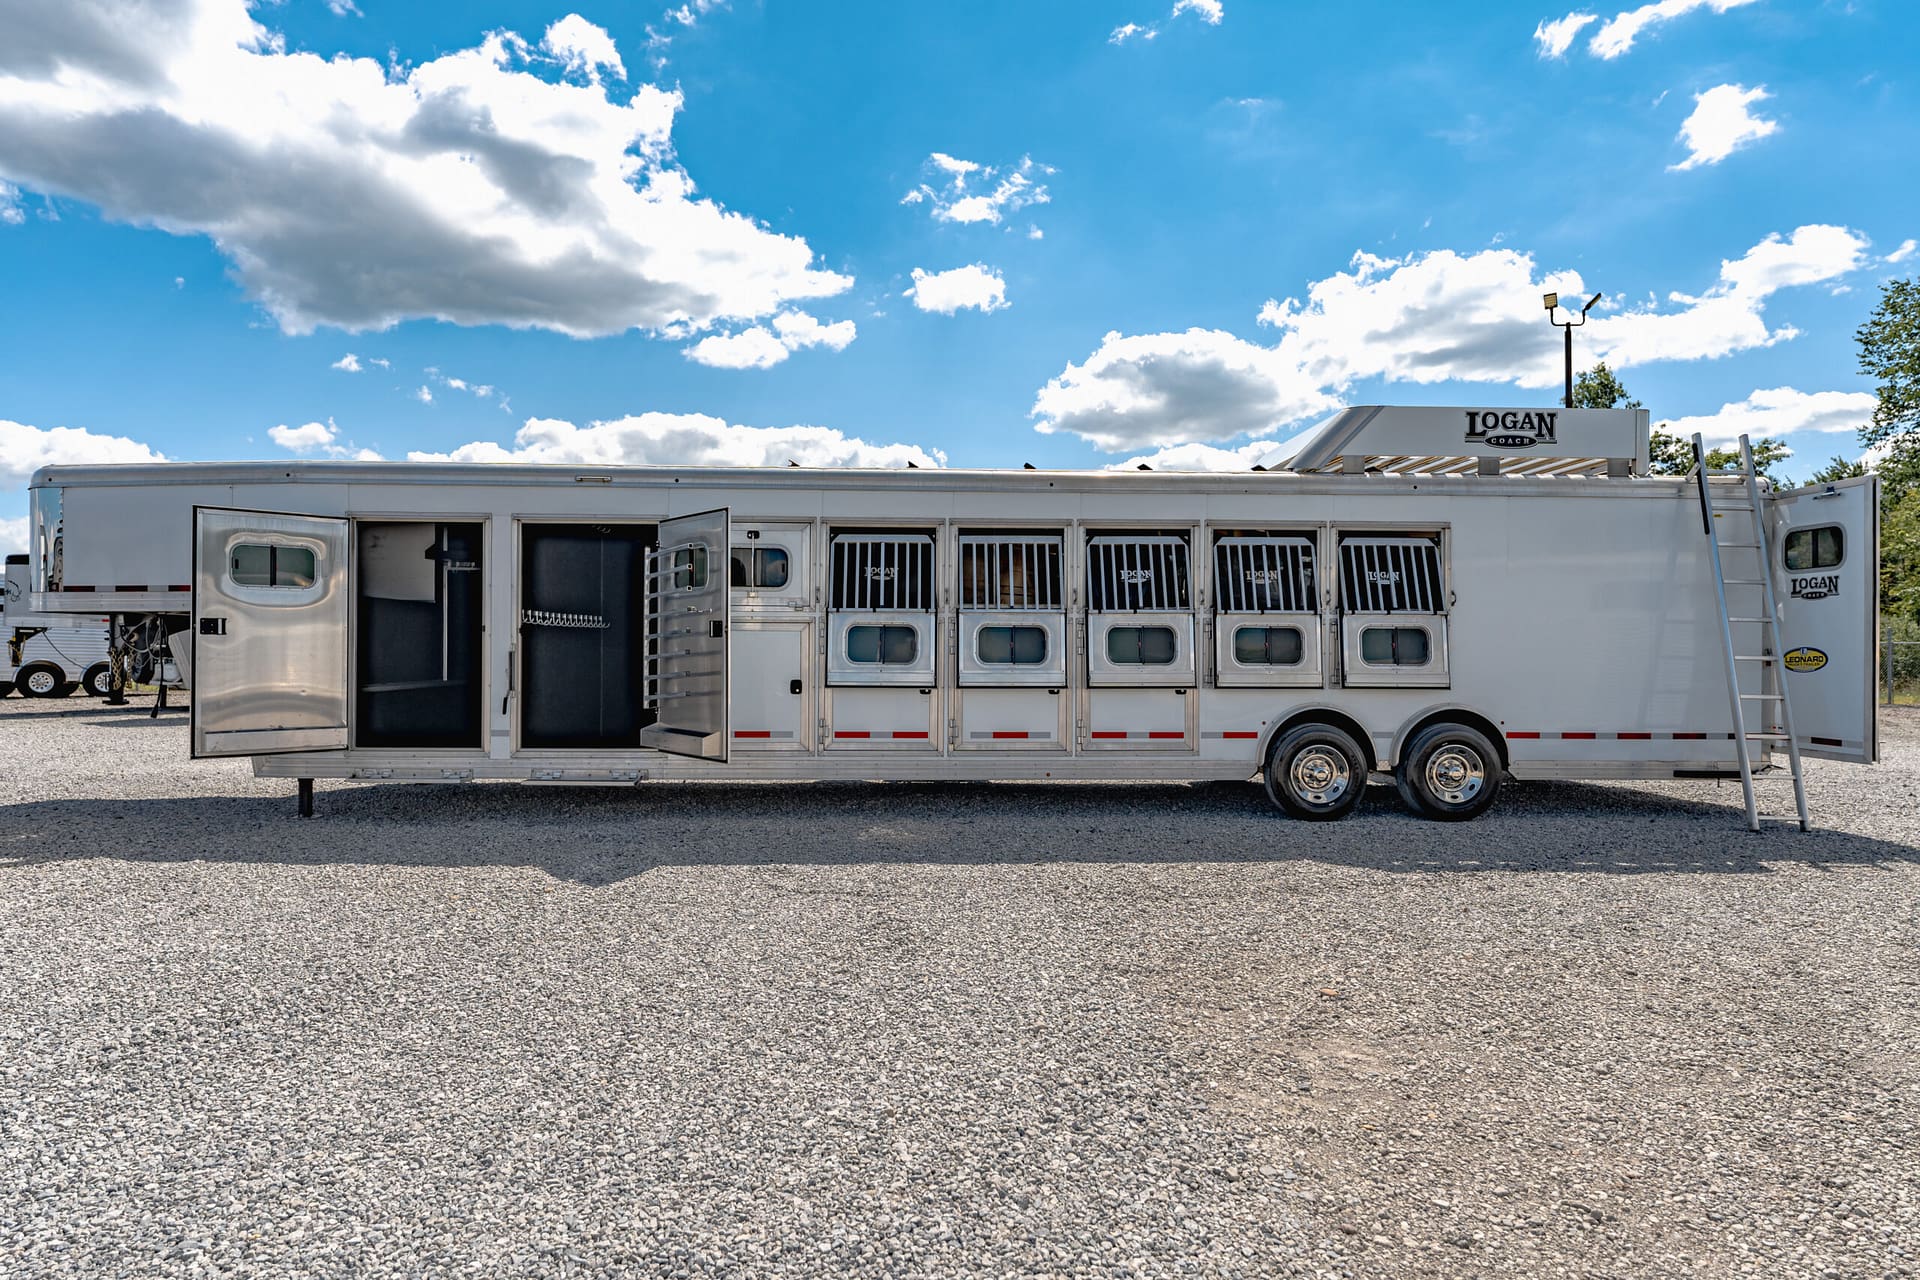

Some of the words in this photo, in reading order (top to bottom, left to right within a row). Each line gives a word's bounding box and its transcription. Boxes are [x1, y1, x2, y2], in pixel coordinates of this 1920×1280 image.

[1465, 411, 1557, 438] LOGAN
[1491, 437, 1529, 445] COACH
[1791, 575, 1840, 595] LOGAN
[1784, 655, 1824, 663] LEONARD
